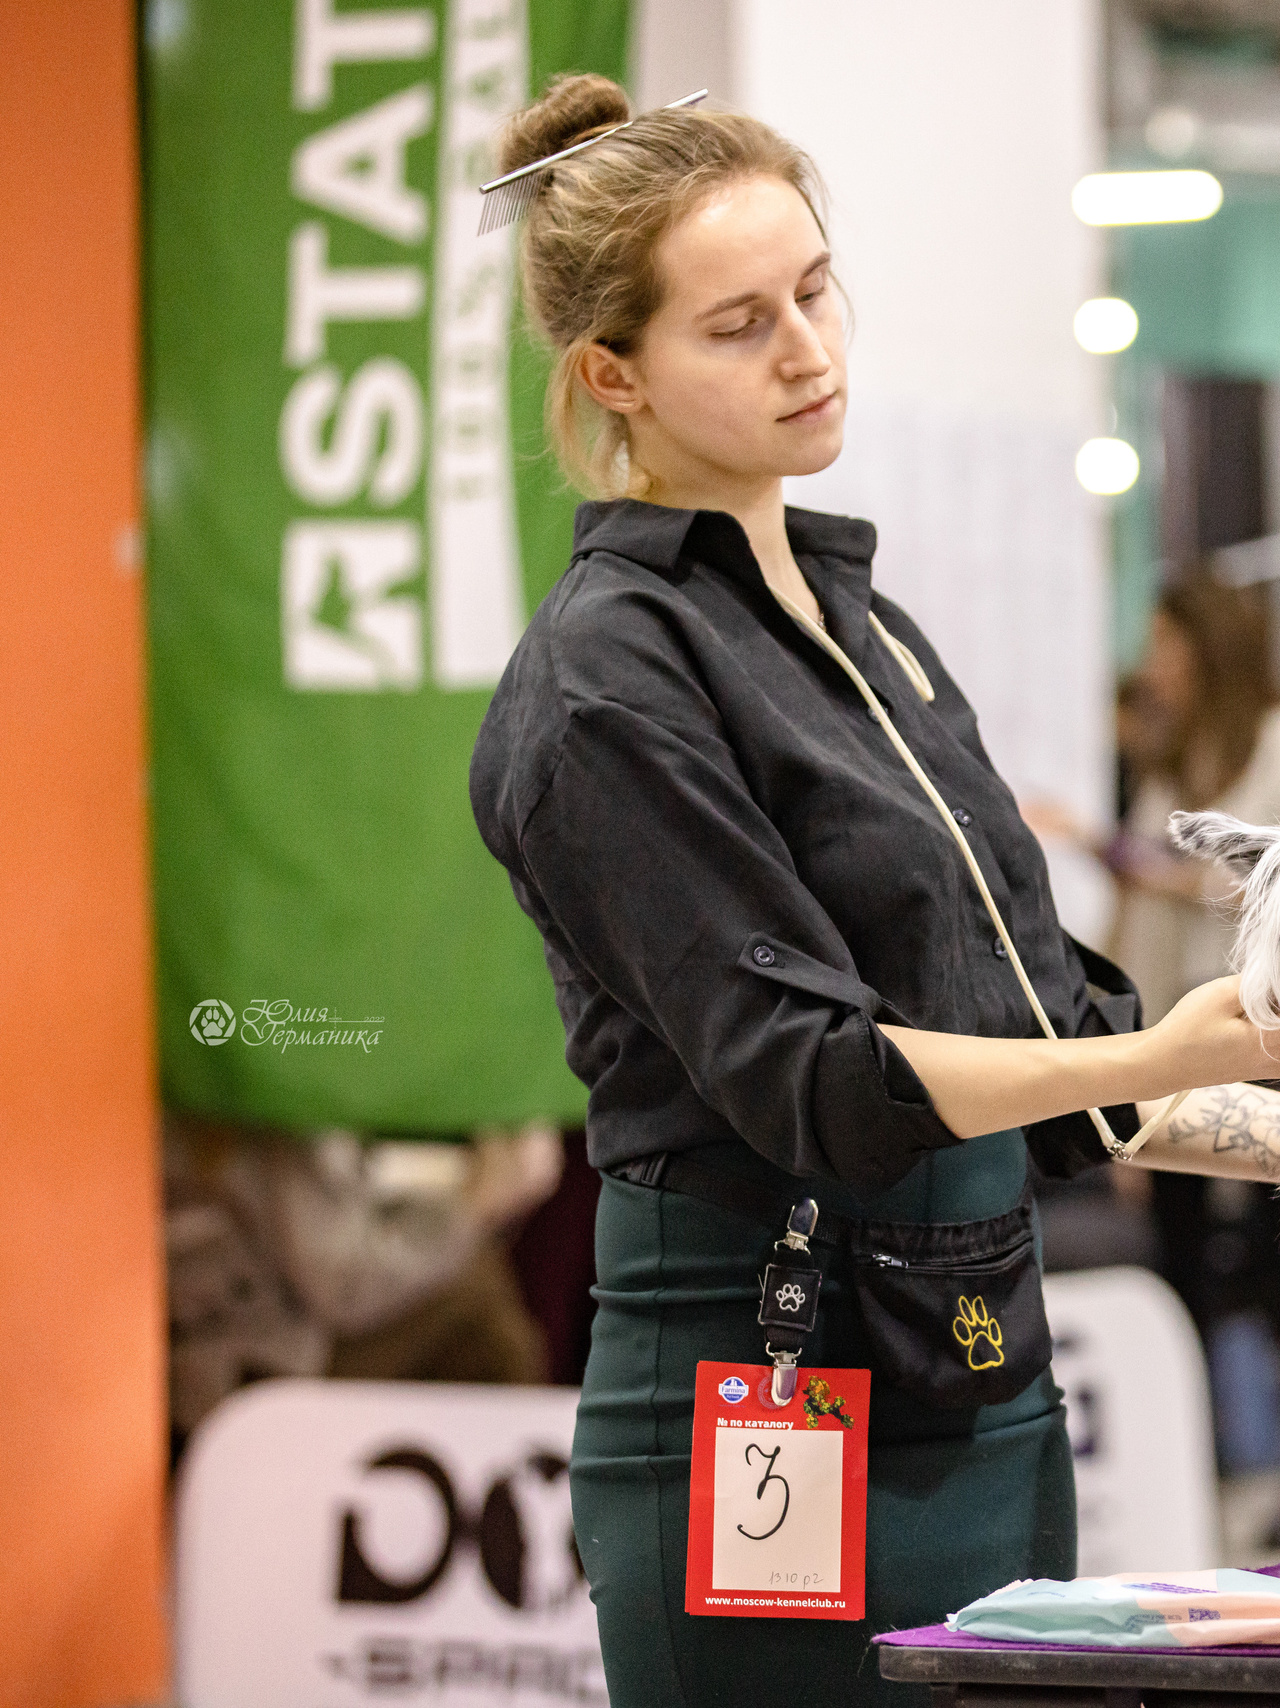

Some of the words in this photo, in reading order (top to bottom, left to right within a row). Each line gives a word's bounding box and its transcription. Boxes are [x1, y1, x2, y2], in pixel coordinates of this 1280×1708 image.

[721, 1386, 746, 1395] Farmina
[717, 1417, 729, 1427] №
[730, 1419, 743, 1427] по
[744, 1420, 794, 1431] каталогу
[736, 1442, 791, 1541] 3
[705, 1597, 846, 1608] www.moscow-kennelclub.ru
